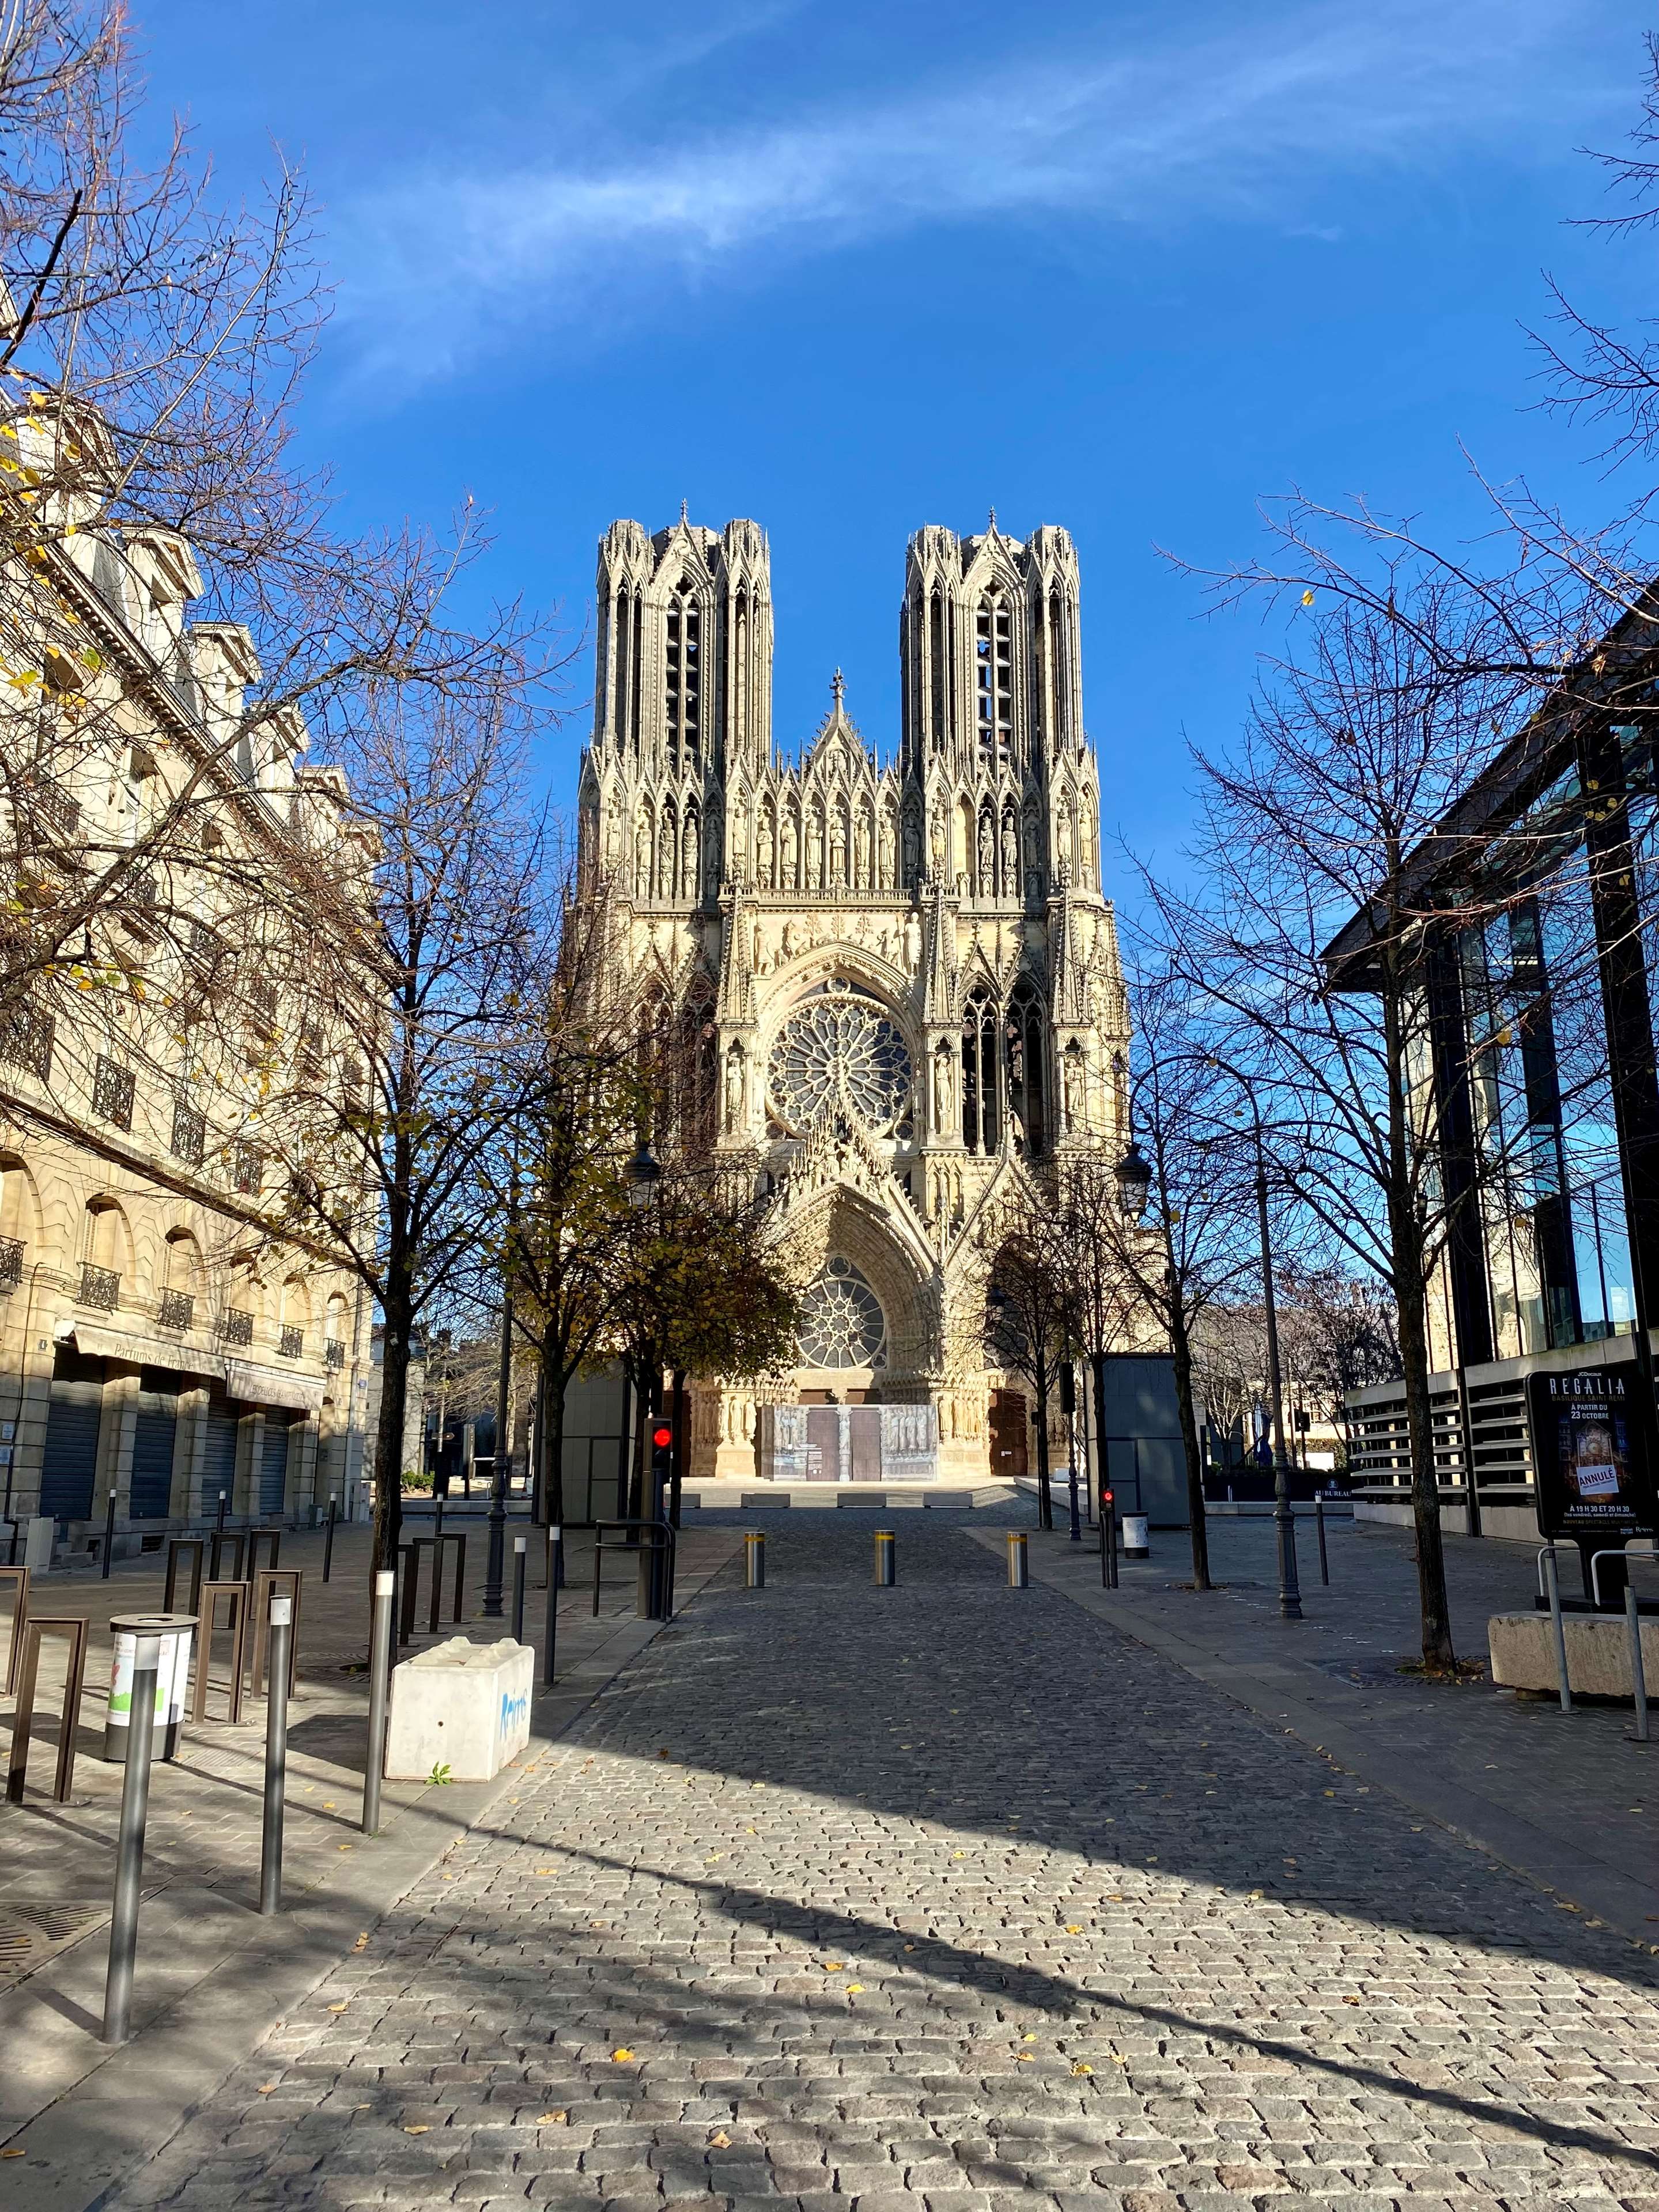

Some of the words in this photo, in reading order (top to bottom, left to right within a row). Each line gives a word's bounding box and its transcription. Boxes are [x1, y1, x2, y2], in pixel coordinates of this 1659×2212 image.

[115, 1344, 151, 1363] Parfums
[154, 1353, 165, 1366] de
[168, 1355, 194, 1370] France
[1550, 1378, 1624, 1394] REGALIA
[1571, 1411, 1581, 1419] 23
[1579, 1468, 1615, 1486] ANNULÉ
